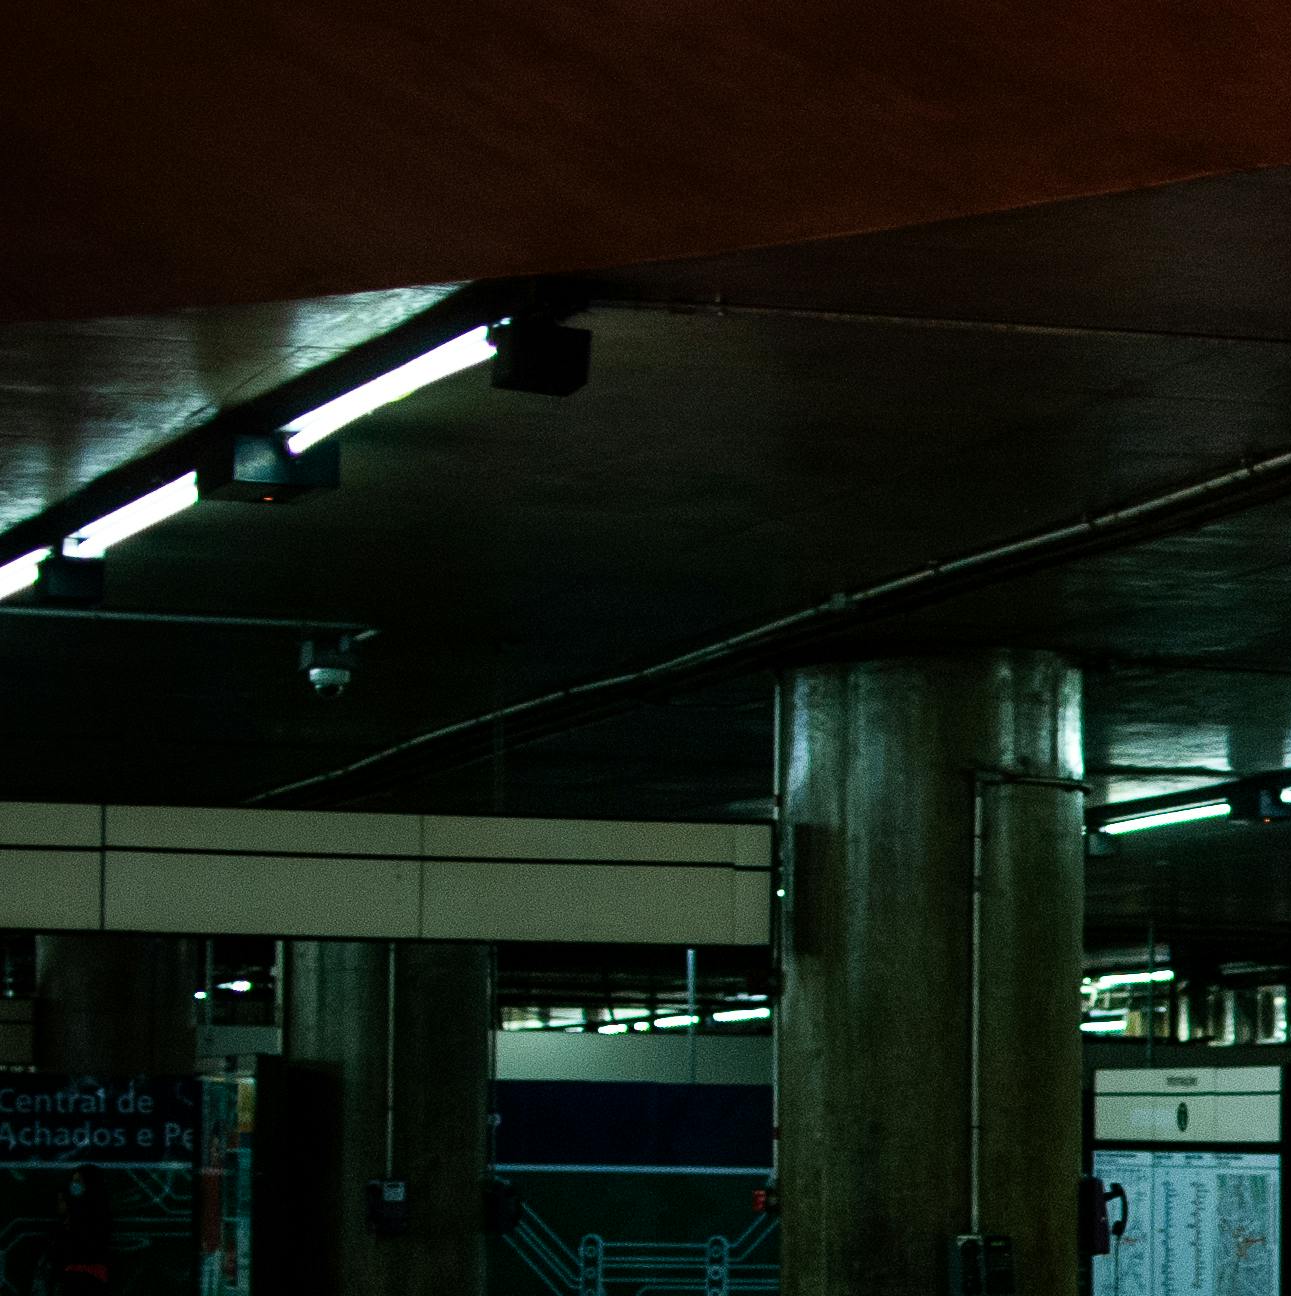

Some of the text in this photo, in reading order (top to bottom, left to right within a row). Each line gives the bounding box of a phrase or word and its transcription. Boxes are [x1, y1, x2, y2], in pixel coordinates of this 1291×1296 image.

[0, 1079, 155, 1115] Central de
[0, 1119, 127, 1150] Achados
[136, 1127, 155, 1148] e
